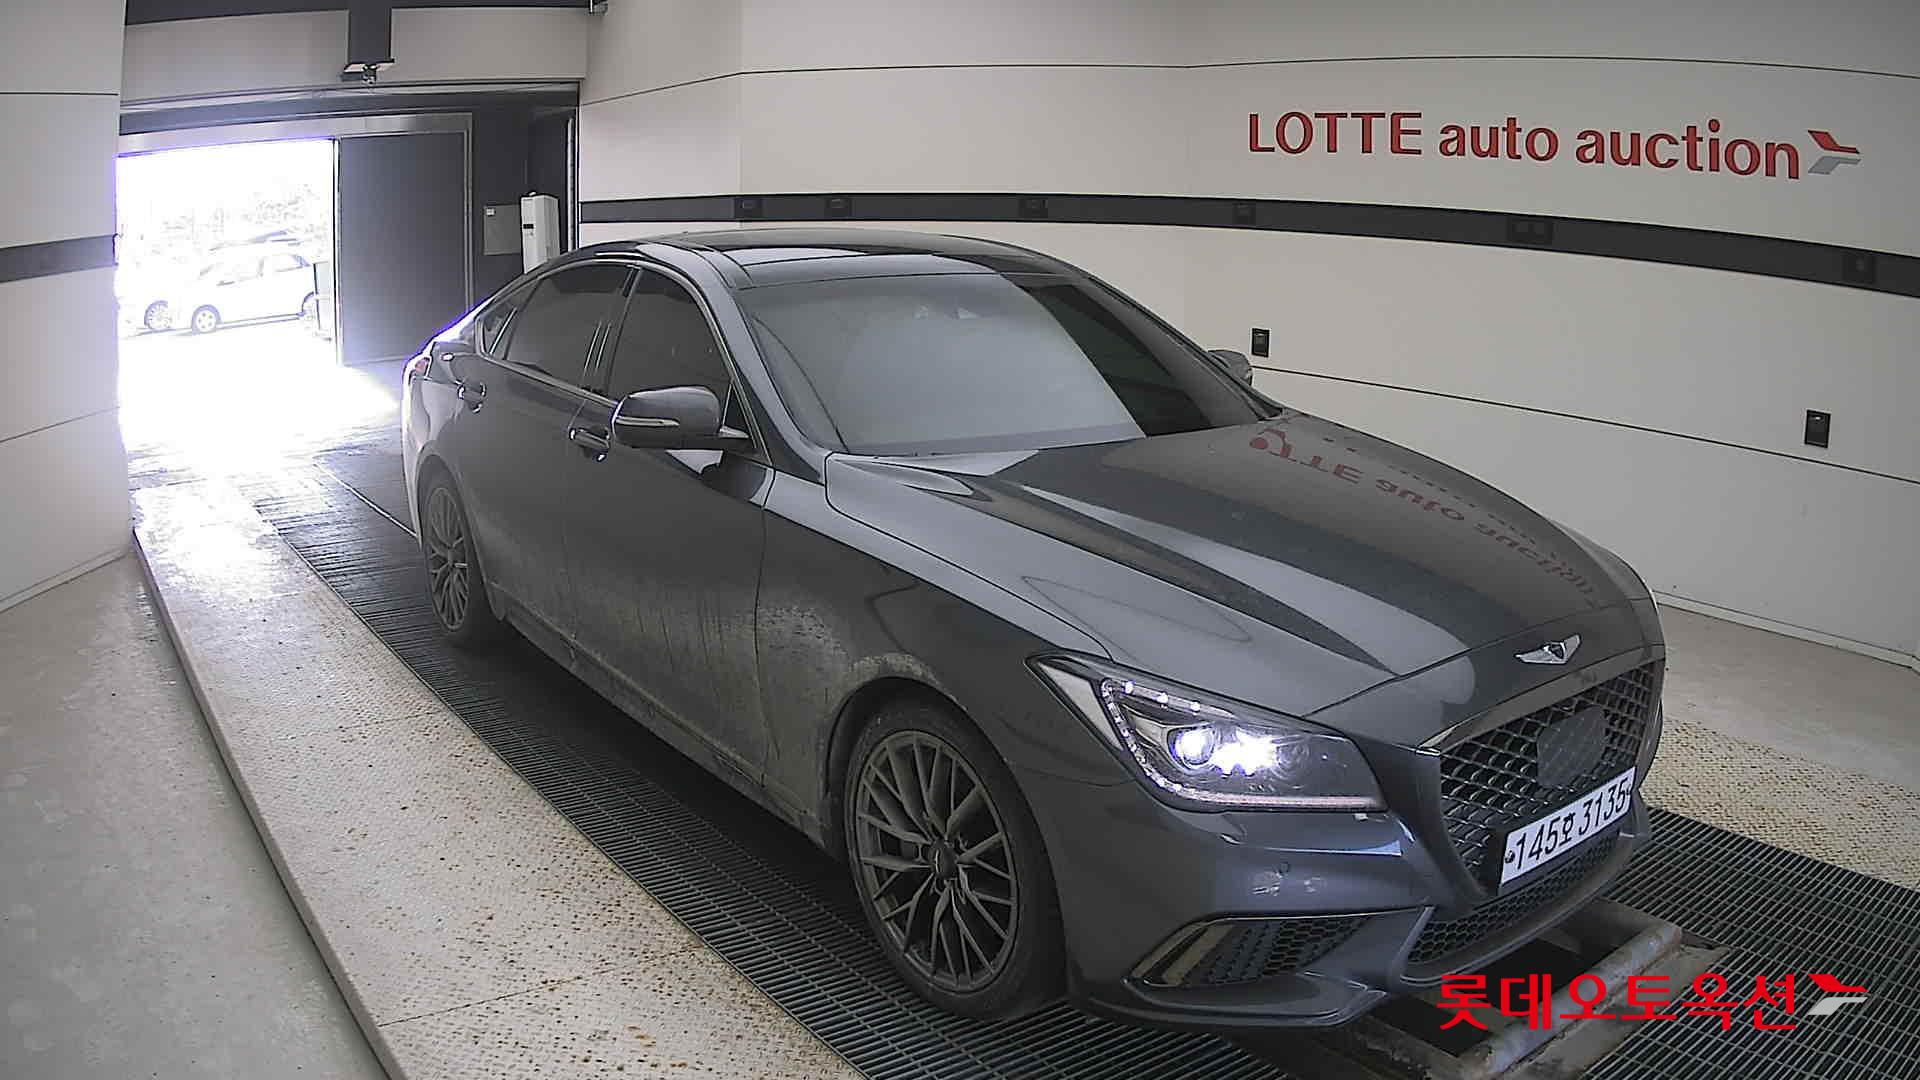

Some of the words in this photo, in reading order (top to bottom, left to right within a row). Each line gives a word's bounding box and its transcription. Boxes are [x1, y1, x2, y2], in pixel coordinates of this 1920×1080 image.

[1248, 111, 1423, 156] LOTTE
[1440, 118, 1560, 160] auto
[1576, 119, 1801, 179] auction
[1578, 777, 1628, 836] 3135
